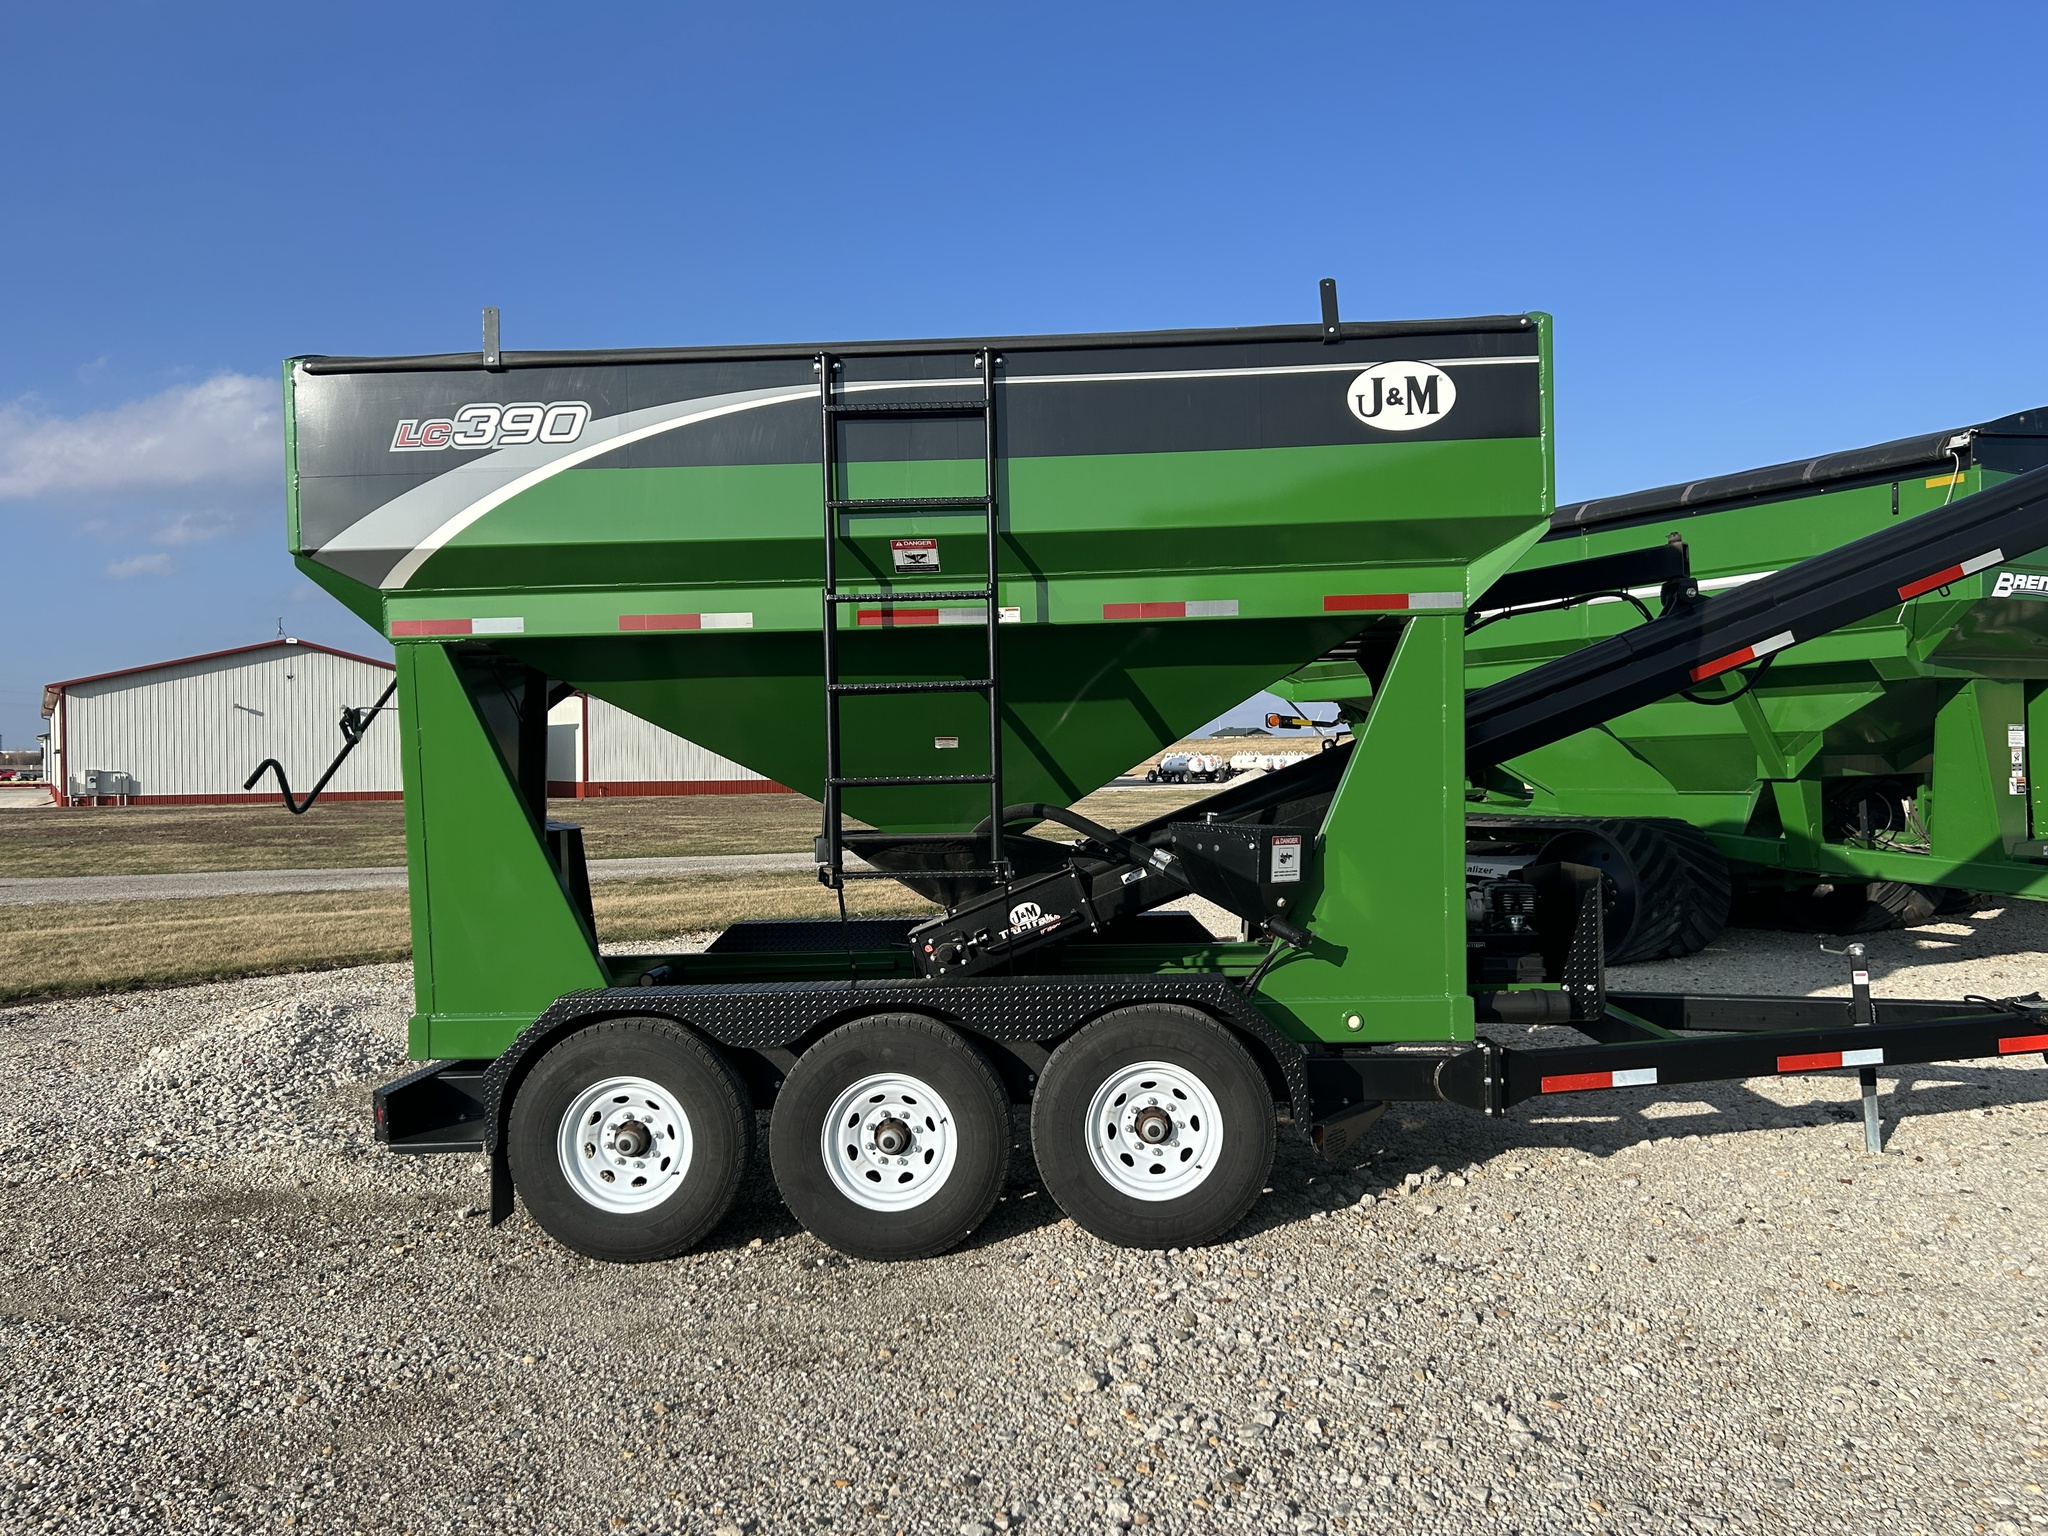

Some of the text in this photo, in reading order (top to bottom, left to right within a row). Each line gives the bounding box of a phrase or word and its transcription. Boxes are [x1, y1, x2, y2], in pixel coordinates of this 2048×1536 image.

[1355, 374, 1441, 418] J&M
[394, 401, 590, 449] LC390
[1466, 865, 1494, 875] alizer
[1012, 904, 1038, 924] J&M
